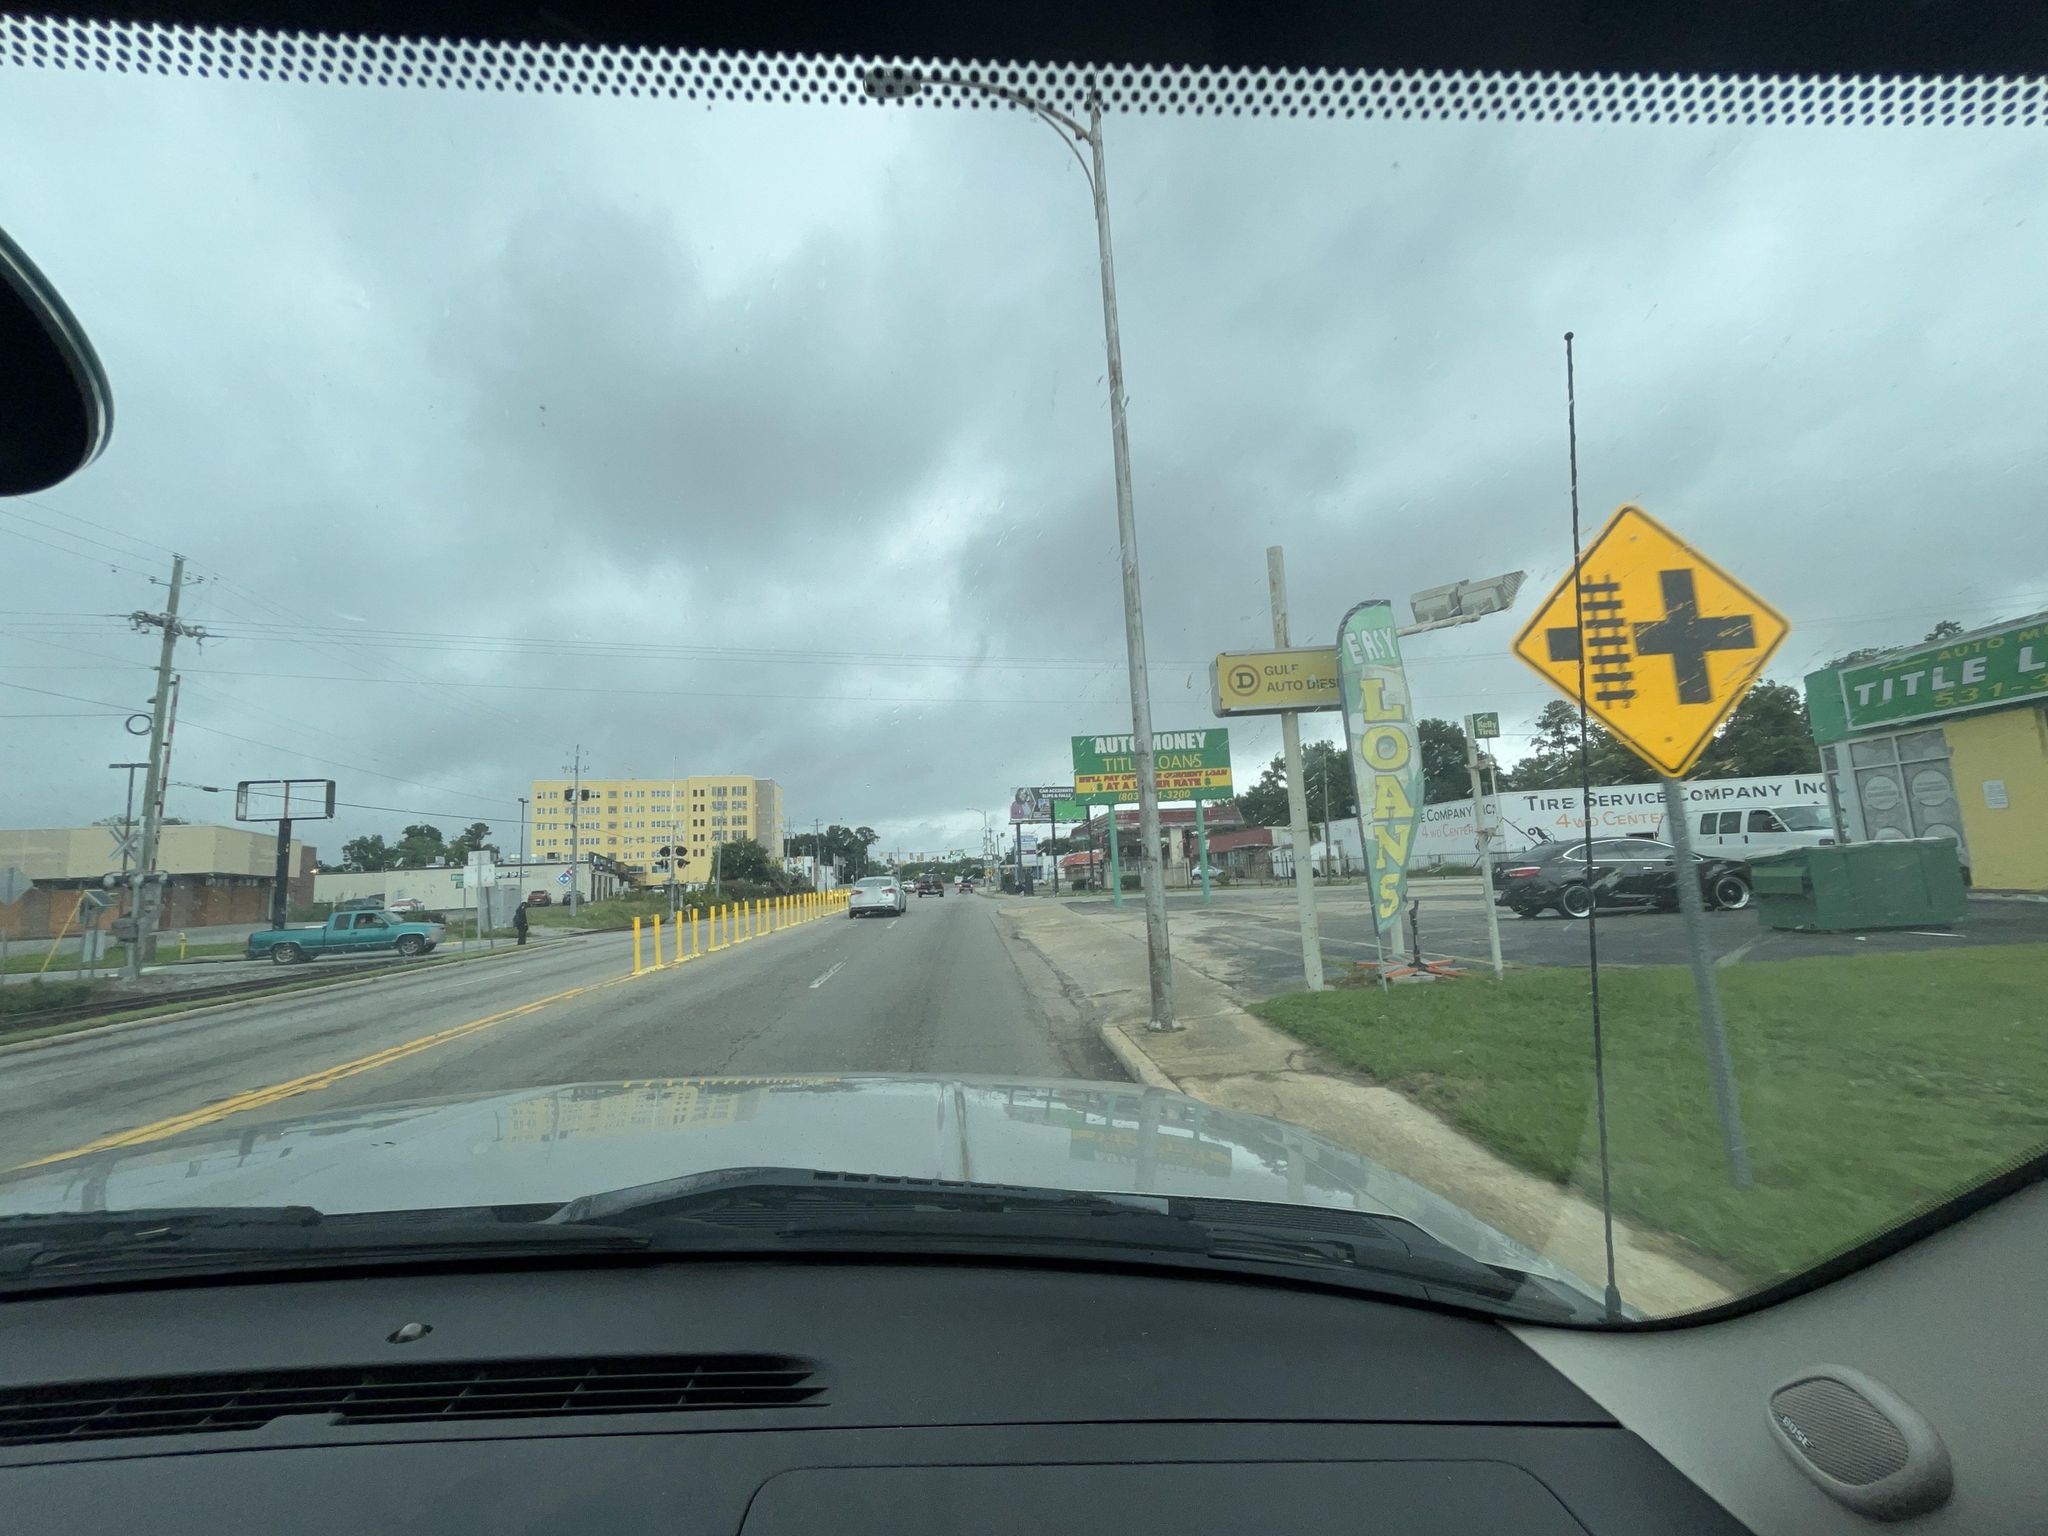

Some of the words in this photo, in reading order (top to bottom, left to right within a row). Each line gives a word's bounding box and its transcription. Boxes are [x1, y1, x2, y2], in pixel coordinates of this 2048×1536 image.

[1343, 627, 1396, 664] EASY
[1938, 637, 2005, 662] AUTO
[1264, 663, 1299, 676] GULF
[1236, 672, 1255, 689] D
[1266, 680, 1303, 692] AUTO
[1854, 656, 1988, 706] TITLE
[1477, 720, 1497, 729] Kelly
[1102, 756, 1137, 772] TITL
[1154, 753, 1202, 769] OANS
[1106, 782, 1120, 790] AT
[1122, 781, 1130, 789] A
[1173, 777, 1201, 787] RATE
[1359, 677, 1414, 919] LOANS
[1523, 794, 1576, 813] TIRE
[1584, 791, 1668, 807] SERVICE
[1426, 806, 1473, 822] COMPANY
[1555, 812, 1599, 829] 4WD
[1442, 824, 1474, 838] CENTER
[1782, 1416, 1811, 1448] BOSE
